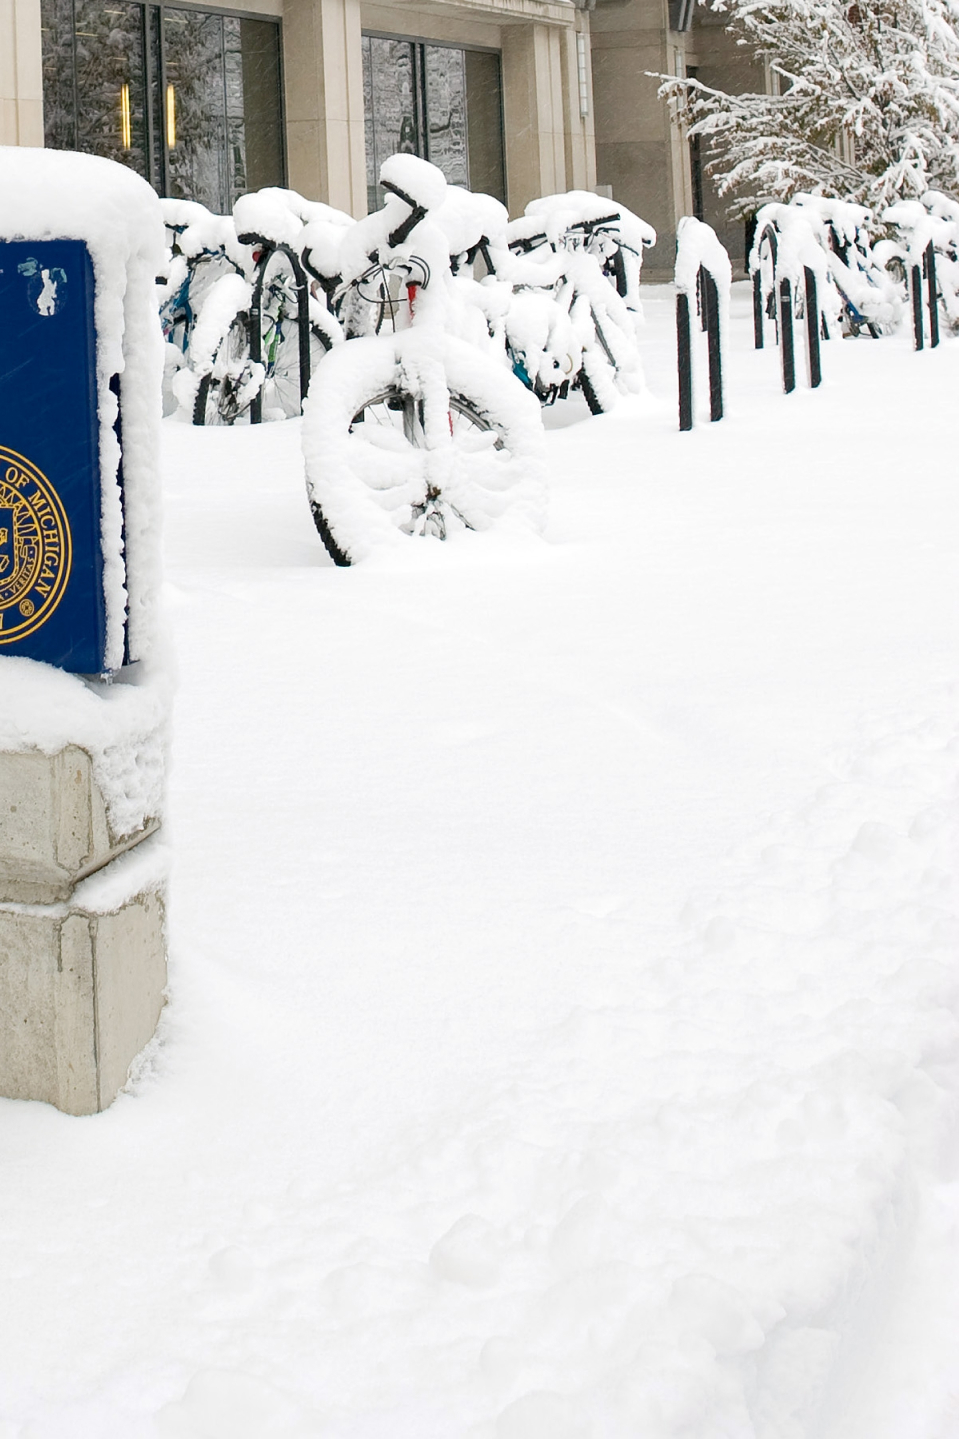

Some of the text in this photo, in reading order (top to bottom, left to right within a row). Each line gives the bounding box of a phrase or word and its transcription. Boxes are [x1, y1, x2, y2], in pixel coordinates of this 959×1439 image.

[4, 466, 30, 489] OF
[27, 489, 60, 598] MICHIGAN
[8, 556, 35, 594] VERITAS
